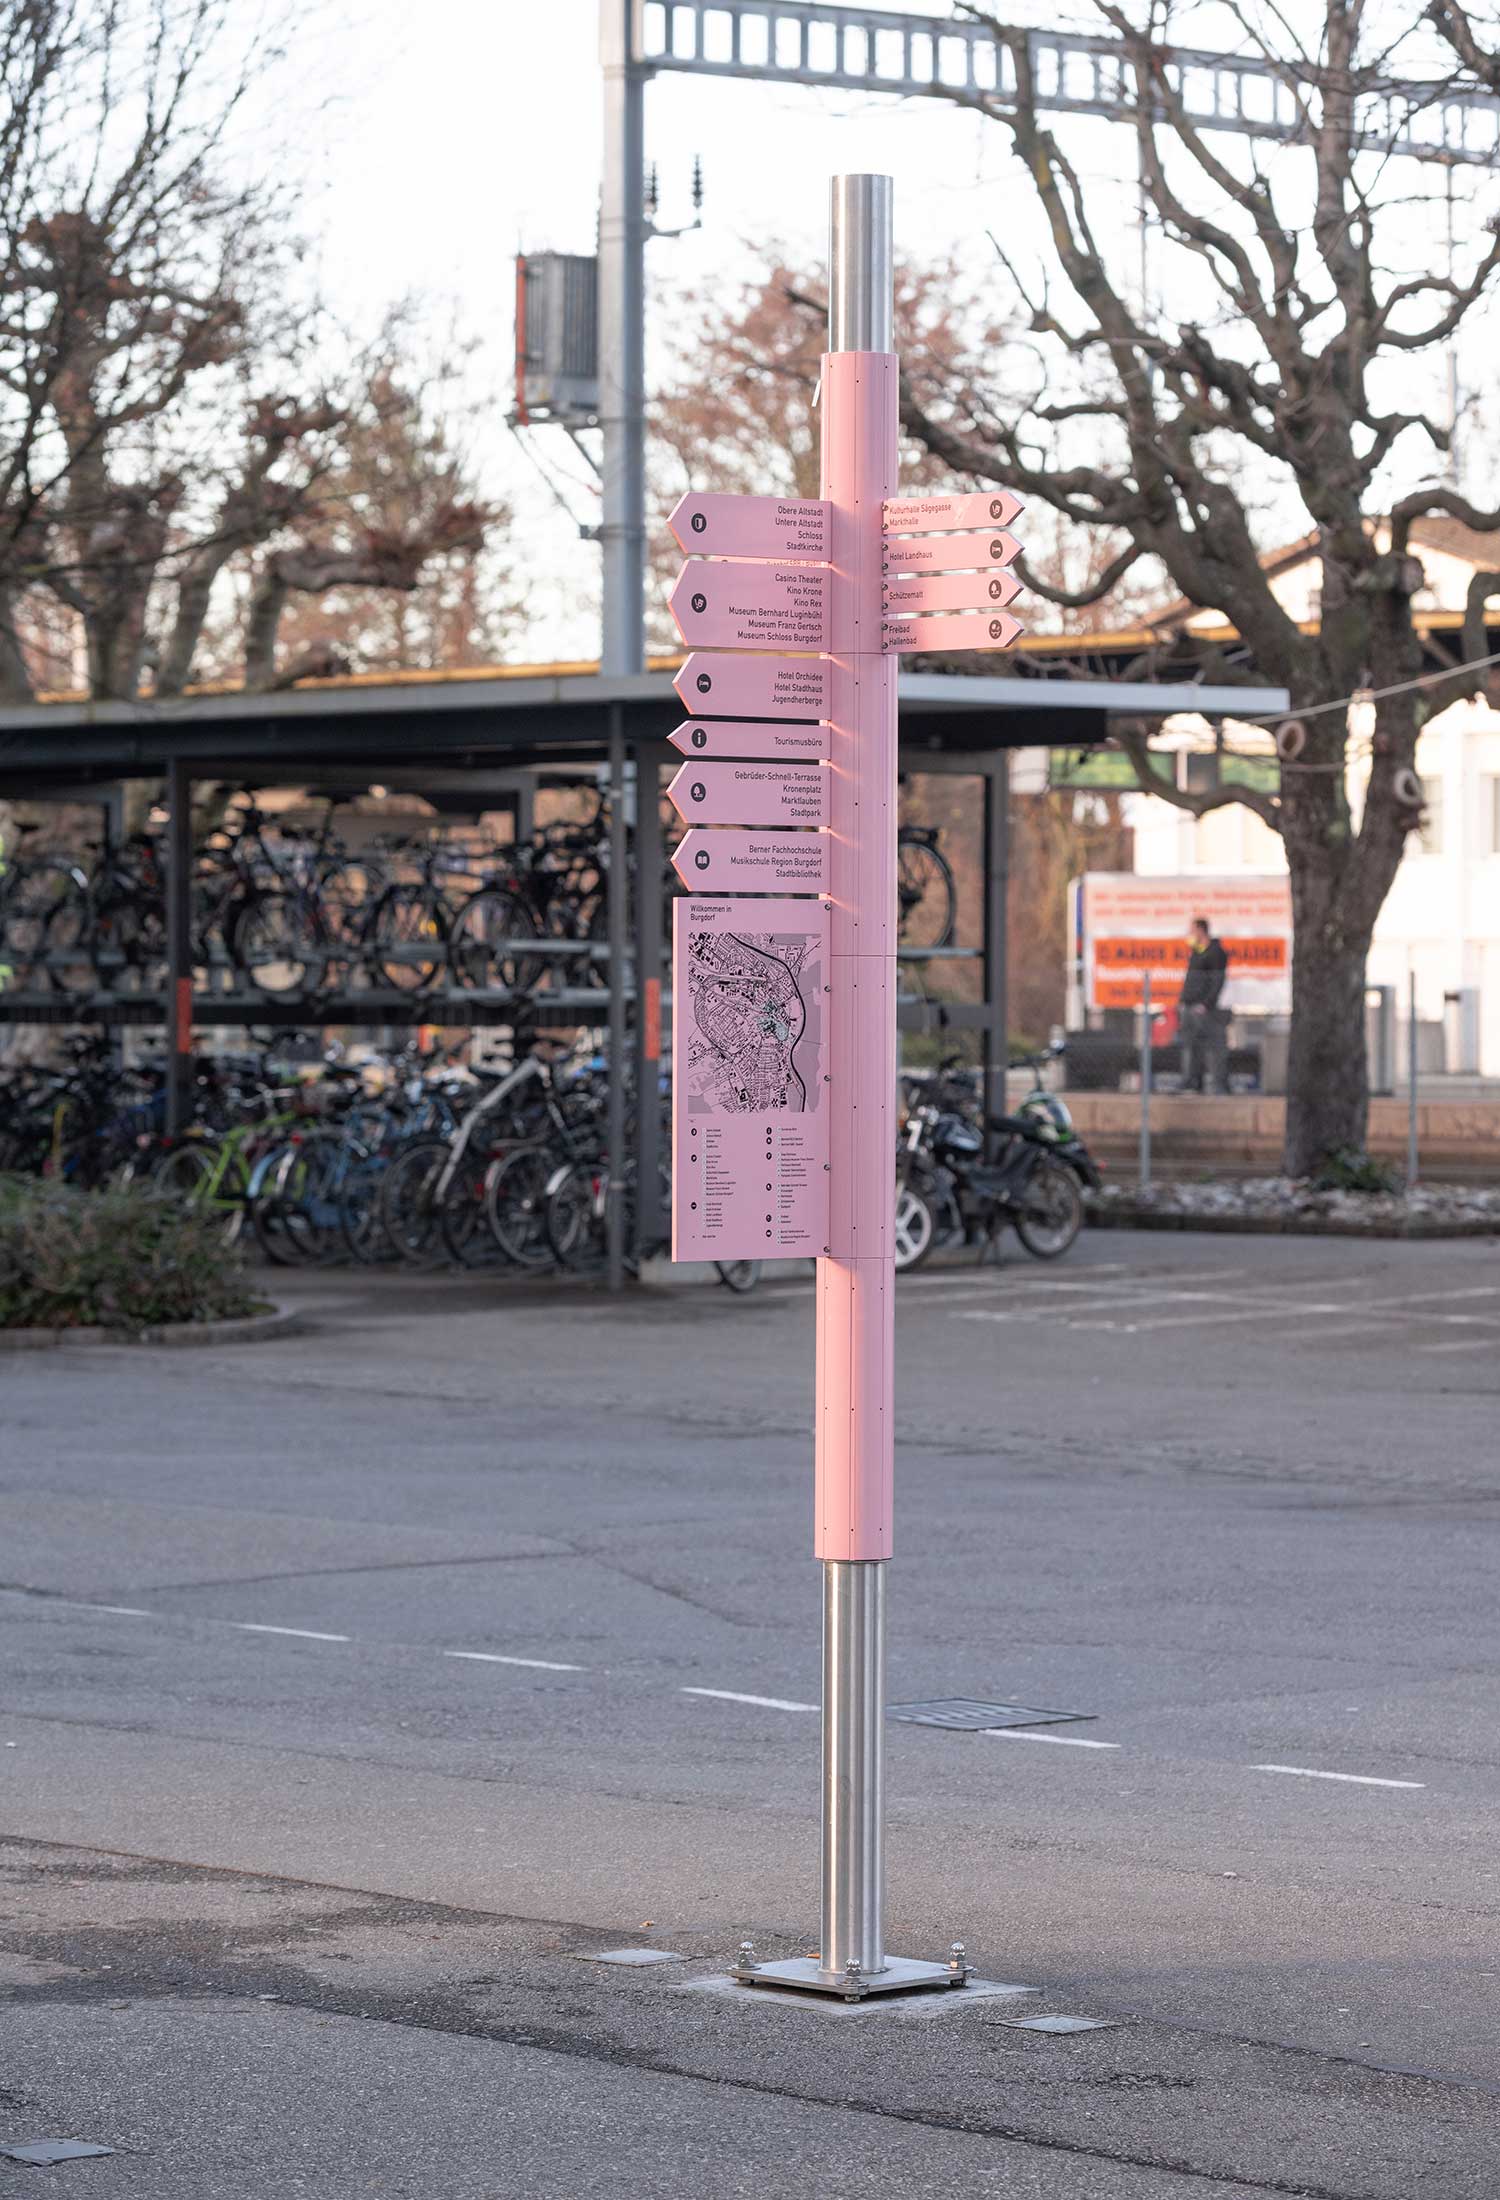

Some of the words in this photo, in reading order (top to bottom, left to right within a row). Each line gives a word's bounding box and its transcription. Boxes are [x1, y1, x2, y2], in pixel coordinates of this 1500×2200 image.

[777, 506, 797, 515] Obere
[798, 506, 823, 516] Altstadt
[921, 503, 951, 514] Sägegasse
[775, 518, 797, 527] Untere
[798, 519, 823, 528] Altstadt
[889, 518, 919, 526] Markthalle
[798, 531, 823, 540] Schloss
[786, 542, 823, 552] Stadtkirche
[889, 552, 904, 561] Hotel
[905, 551, 932, 560] Landhaus
[775, 574, 797, 583] Casino
[798, 574, 823, 584] Theater
[787, 587, 801, 595] Kino
[802, 587, 822, 596] Krone
[810, 599, 822, 607] Rex
[729, 607, 757, 616] Museum
[759, 608, 789, 618] Bernhard
[790, 609, 822, 620] Luginbühl
[748, 620, 776, 628] Museum
[778, 621, 796, 630] Franz
[798, 621, 822, 630] Gertsch
[889, 625, 910, 634] Freibad
[738, 631, 766, 640] Museum
[767, 632, 792, 641] Schloss
[794, 633, 822, 644] Burgdorf
[889, 636, 917, 646] Hallenbad
[778, 672, 794, 680] Hotel
[796, 672, 823, 681] Orchidee
[774, 683, 791, 692] Hotel
[792, 684, 822, 693] Stadthaus
[772, 695, 823, 706] Jugendherberge
[774, 737, 822, 746] Tourismusbüro
[735, 771, 822, 782] Gebrüder-Schnell-Terrasse
[783, 785, 822, 795] Kronenplatz
[781, 796, 822, 805] Marktlauben
[790, 808, 822, 819] Stadtpark
[749, 845, 770, 854] Berner
[772, 845, 822, 855] Fachhochschule
[730, 857, 770, 865] Musikschule
[771, 858, 793, 867] Region
[794, 858, 822, 868] Burgdorf
[776, 869, 822, 878] Stadtbibliothek
[690, 913, 716, 922] Burgdorf
